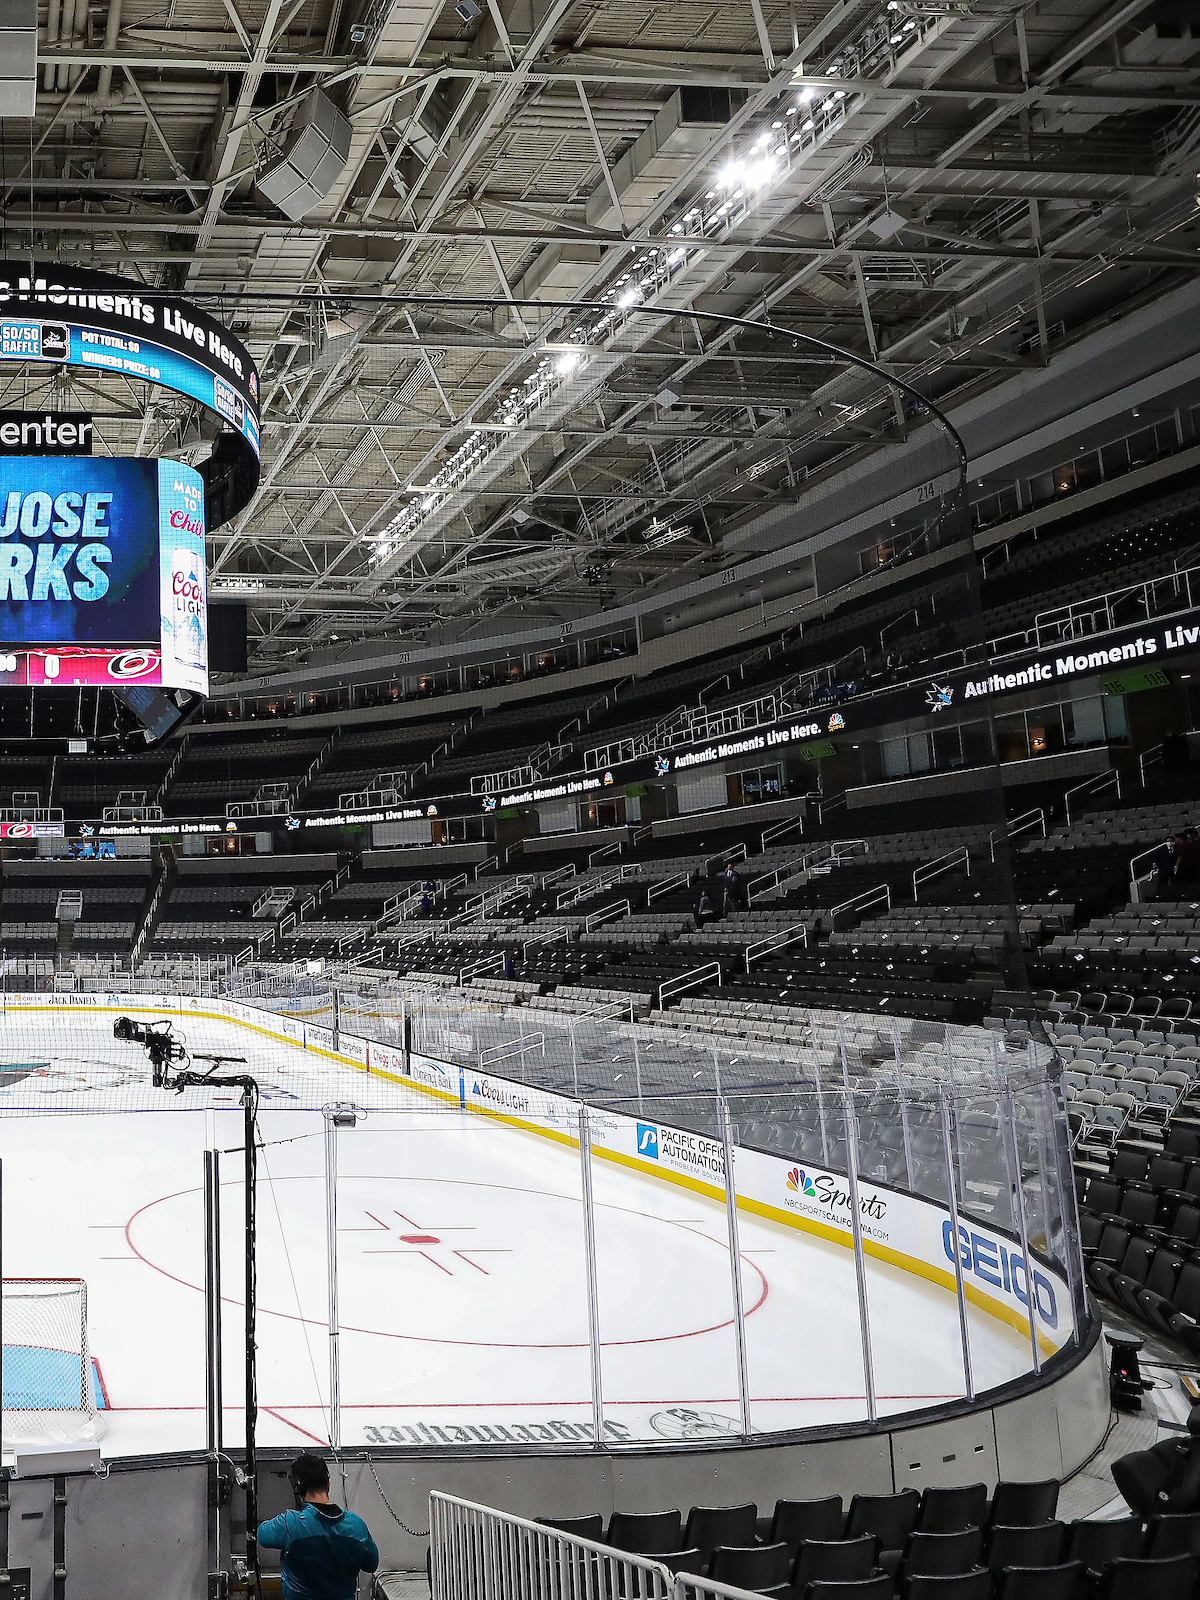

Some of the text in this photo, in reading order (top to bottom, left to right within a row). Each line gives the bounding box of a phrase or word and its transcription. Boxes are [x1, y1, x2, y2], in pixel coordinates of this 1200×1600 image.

[2, 326, 39, 341] 50/50
[19, 277, 155, 324] Moments
[164, 307, 205, 347] Live
[209, 331, 244, 380] Here.
[2, 340, 39, 354] RAFFLE
[81, 330, 140, 354] POT TOTAL: $0
[81, 350, 123, 369] WINNERS
[123, 359, 150, 376] PRIZE:
[173, 479, 202, 503] MADE
[917, 482, 934, 502] 214
[183, 496, 197, 512] TO
[169, 509, 204, 539] Chill
[721, 569, 735, 584] 213
[560, 622, 573, 635] 212
[45, 655, 60, 678] 0
[399, 652, 410, 664] 211
[964, 625, 1200, 698] Authentic Moments Liv
[259, 677, 270, 687] 210
[1104, 671, 1167, 696] 115 116
[674, 721, 822, 769] Authentic Moments Live Here.
[500, 777, 601, 807] Authentic Moments Live Here.
[99, 823, 222, 835] Authentic Moments Live Here.
[305, 808, 424, 827] Authentic Moments Live Here.
[48, 995, 66, 1005] JACK
[339, 1040, 362, 1054] nterprise
[481, 1079, 529, 1113] Coors LIGHT
[661, 1129, 696, 1150] PACIFIC
[662, 1143, 725, 1175] AUTOMATION
[670, 1159, 725, 1183] PROBLEM SOLVED
[784, 1198, 889, 1241] NBCSPORTSCALIFONIA.COM
[942, 1220, 1058, 1331] GEICO
